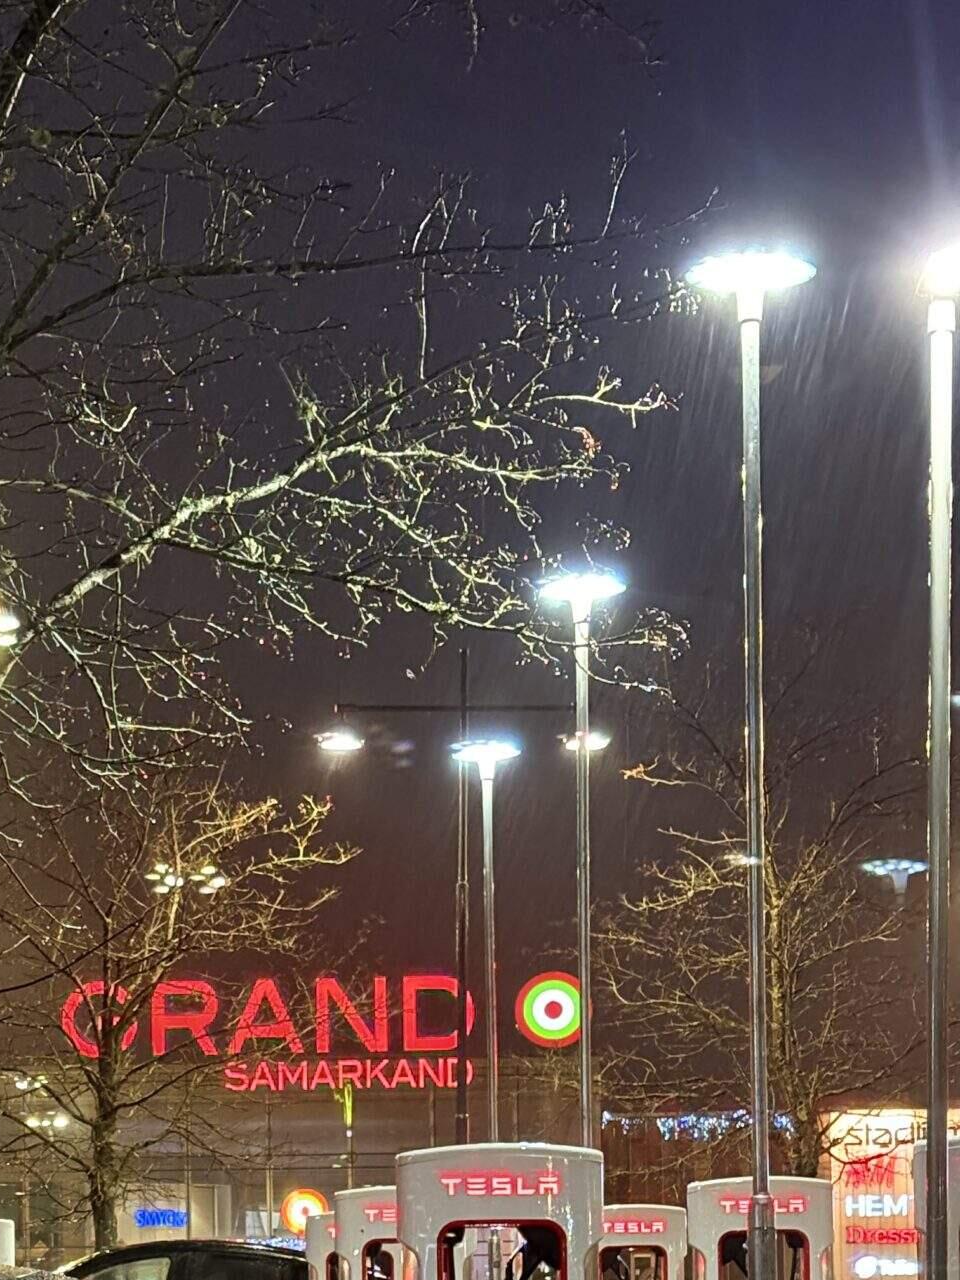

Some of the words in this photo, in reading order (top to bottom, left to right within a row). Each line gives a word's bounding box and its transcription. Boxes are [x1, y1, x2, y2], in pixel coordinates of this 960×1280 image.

[60, 974, 476, 1058] GRAND
[224, 1057, 474, 1091] SAMARKAND
[440, 1177, 559, 1196] TESLA
[720, 1199, 805, 1213] TELA
[844, 1194, 915, 1217] HEM
[602, 1221, 664, 1233] TESLA
